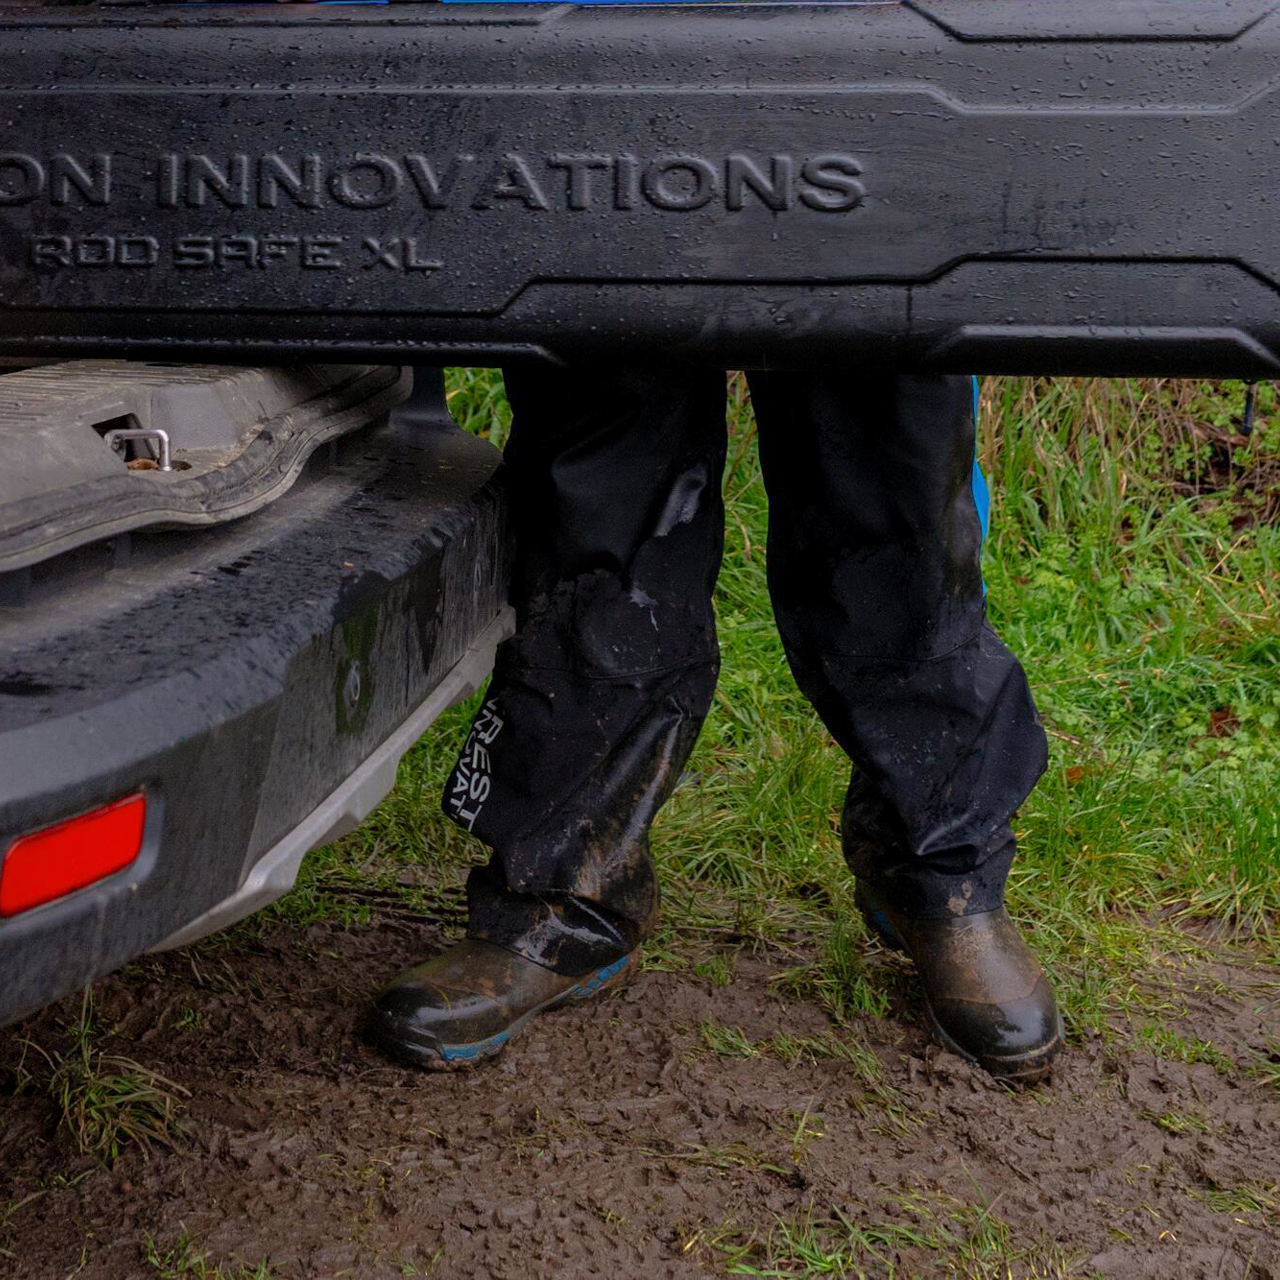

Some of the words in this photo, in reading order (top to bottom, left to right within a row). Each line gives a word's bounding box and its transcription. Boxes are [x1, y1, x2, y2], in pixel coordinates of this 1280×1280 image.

[156, 150, 868, 214] INNOVATIONS
[30, 233, 160, 269] ROD
[171, 234, 342, 271] SAFE
[362, 236, 444, 272] XL
[459, 714, 504, 833] REST
